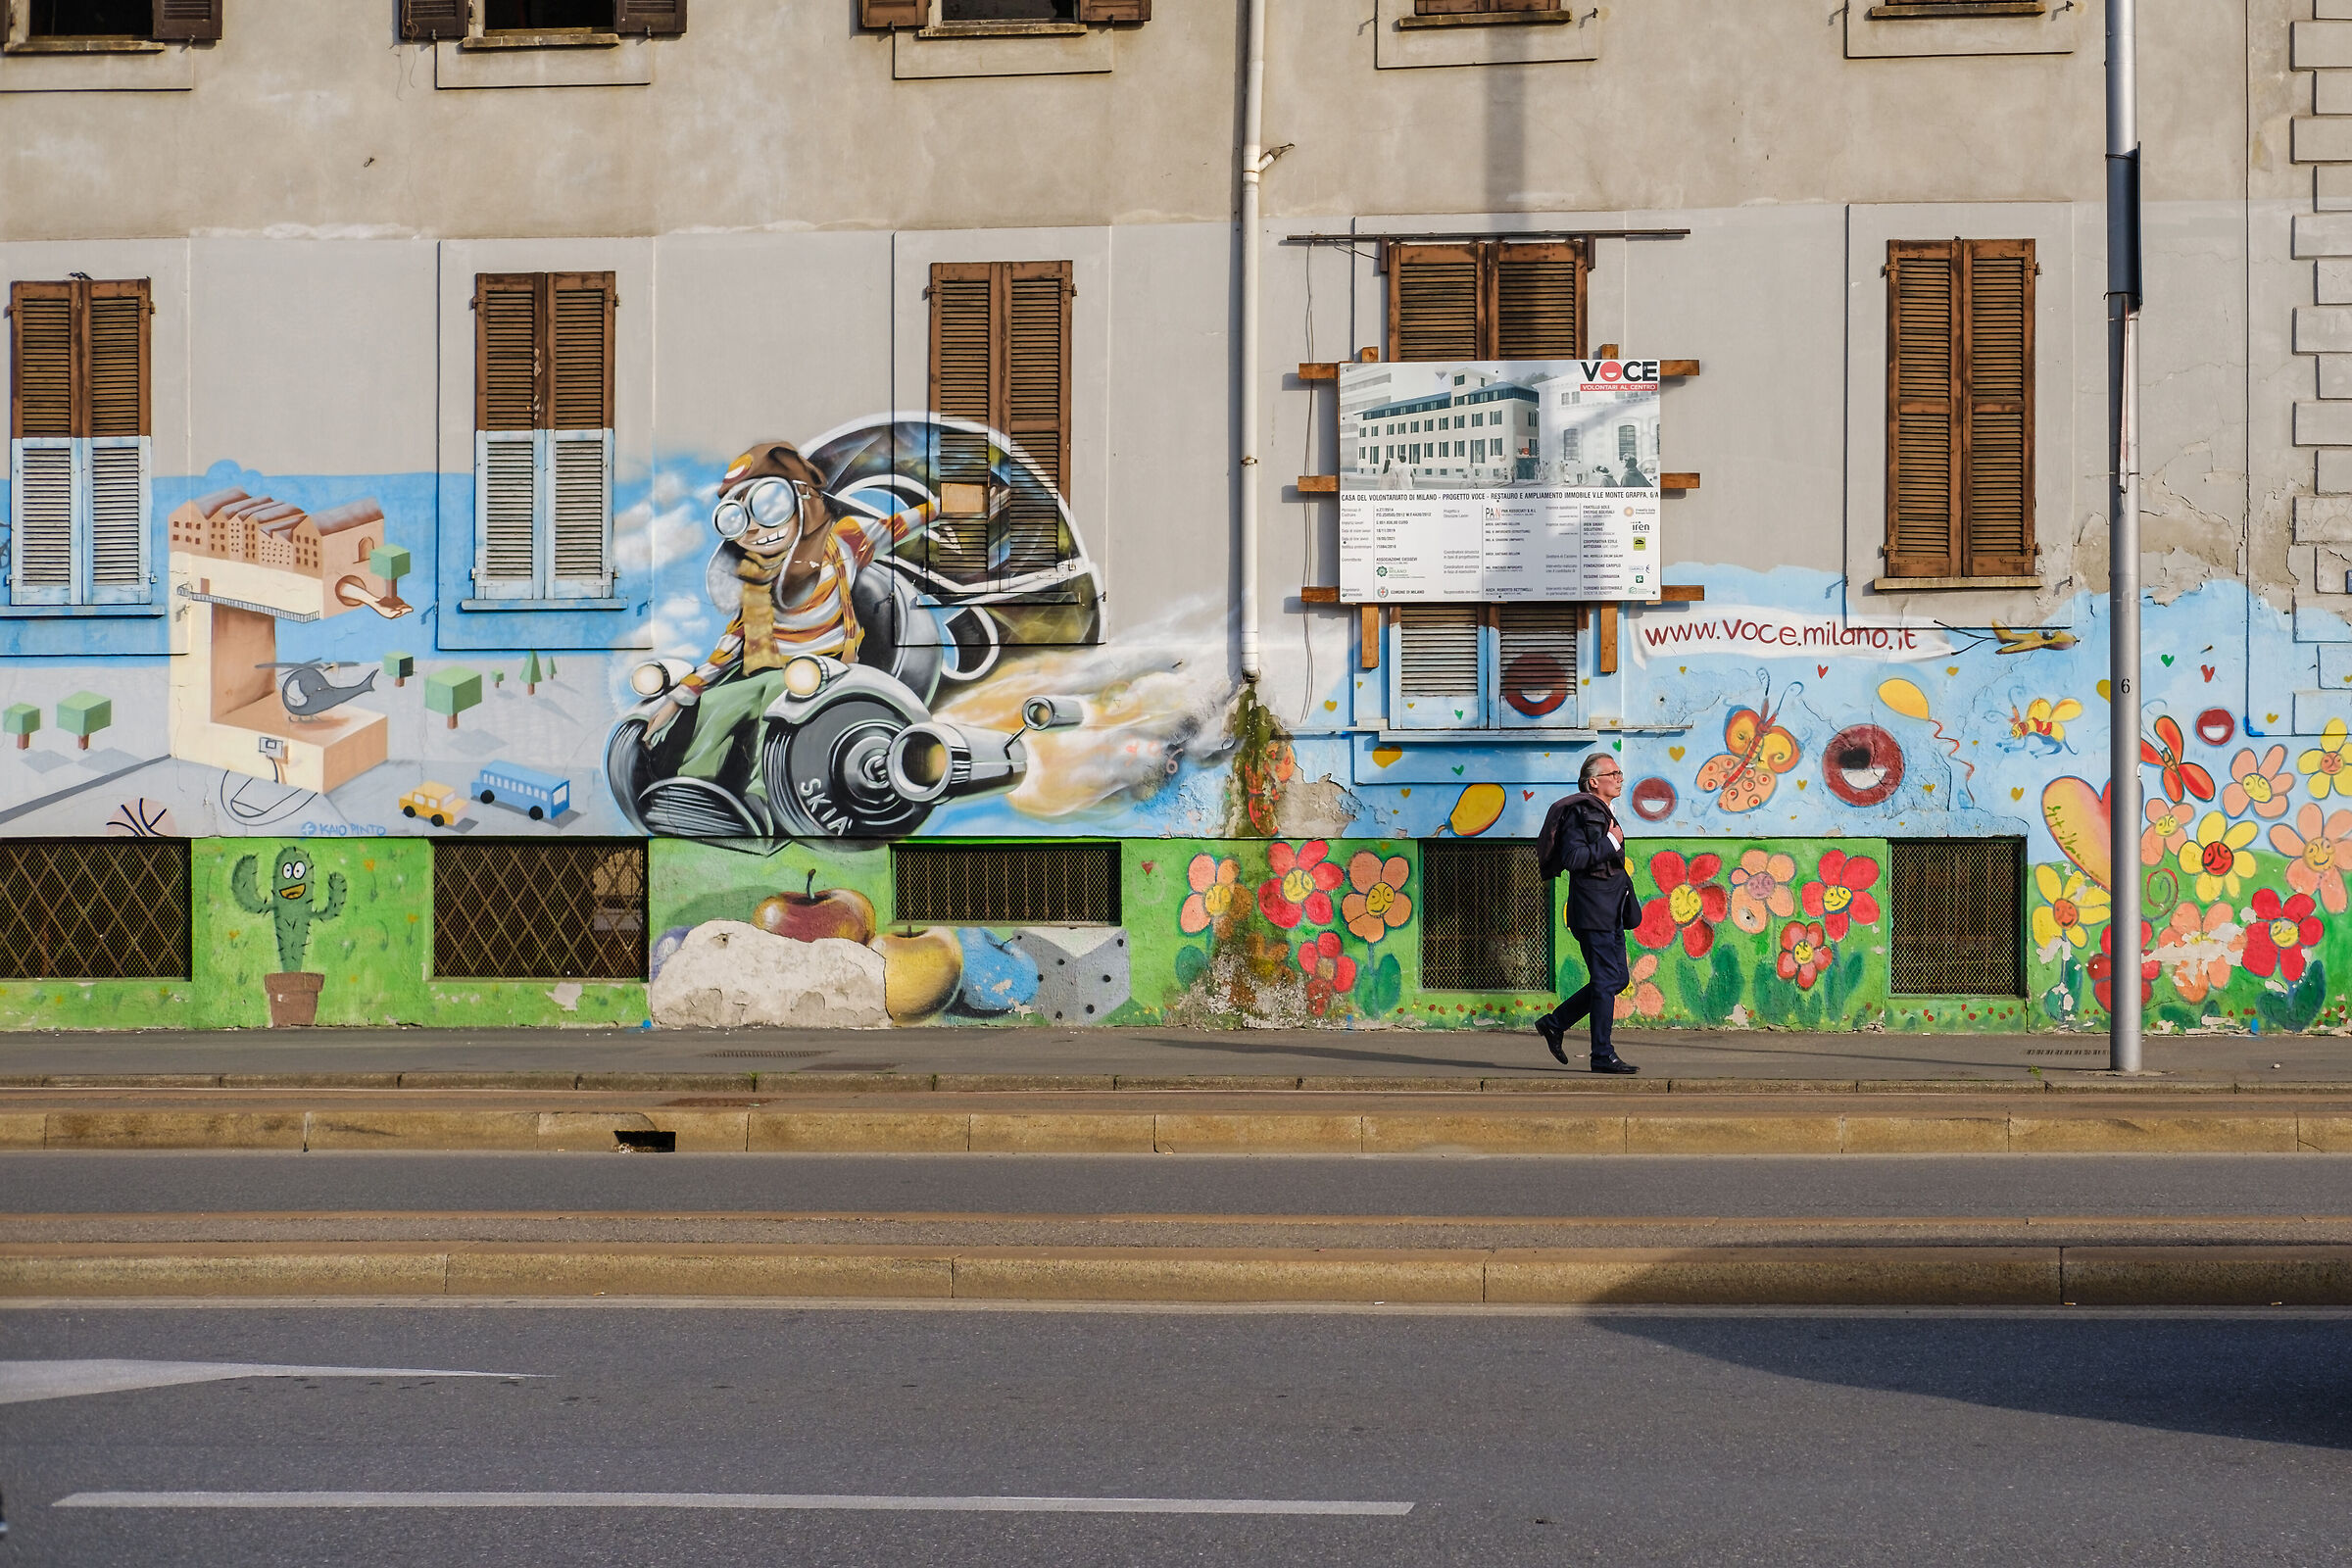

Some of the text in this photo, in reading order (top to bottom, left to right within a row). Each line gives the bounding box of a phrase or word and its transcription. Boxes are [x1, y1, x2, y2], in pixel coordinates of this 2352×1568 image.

[1581, 361, 1657, 382] VOCE
[1632, 522, 1650, 531] iren
[2121, 678, 2130, 693] 6
[320, 823, 347, 836] KAIO
[350, 823, 386, 836] PINTO
